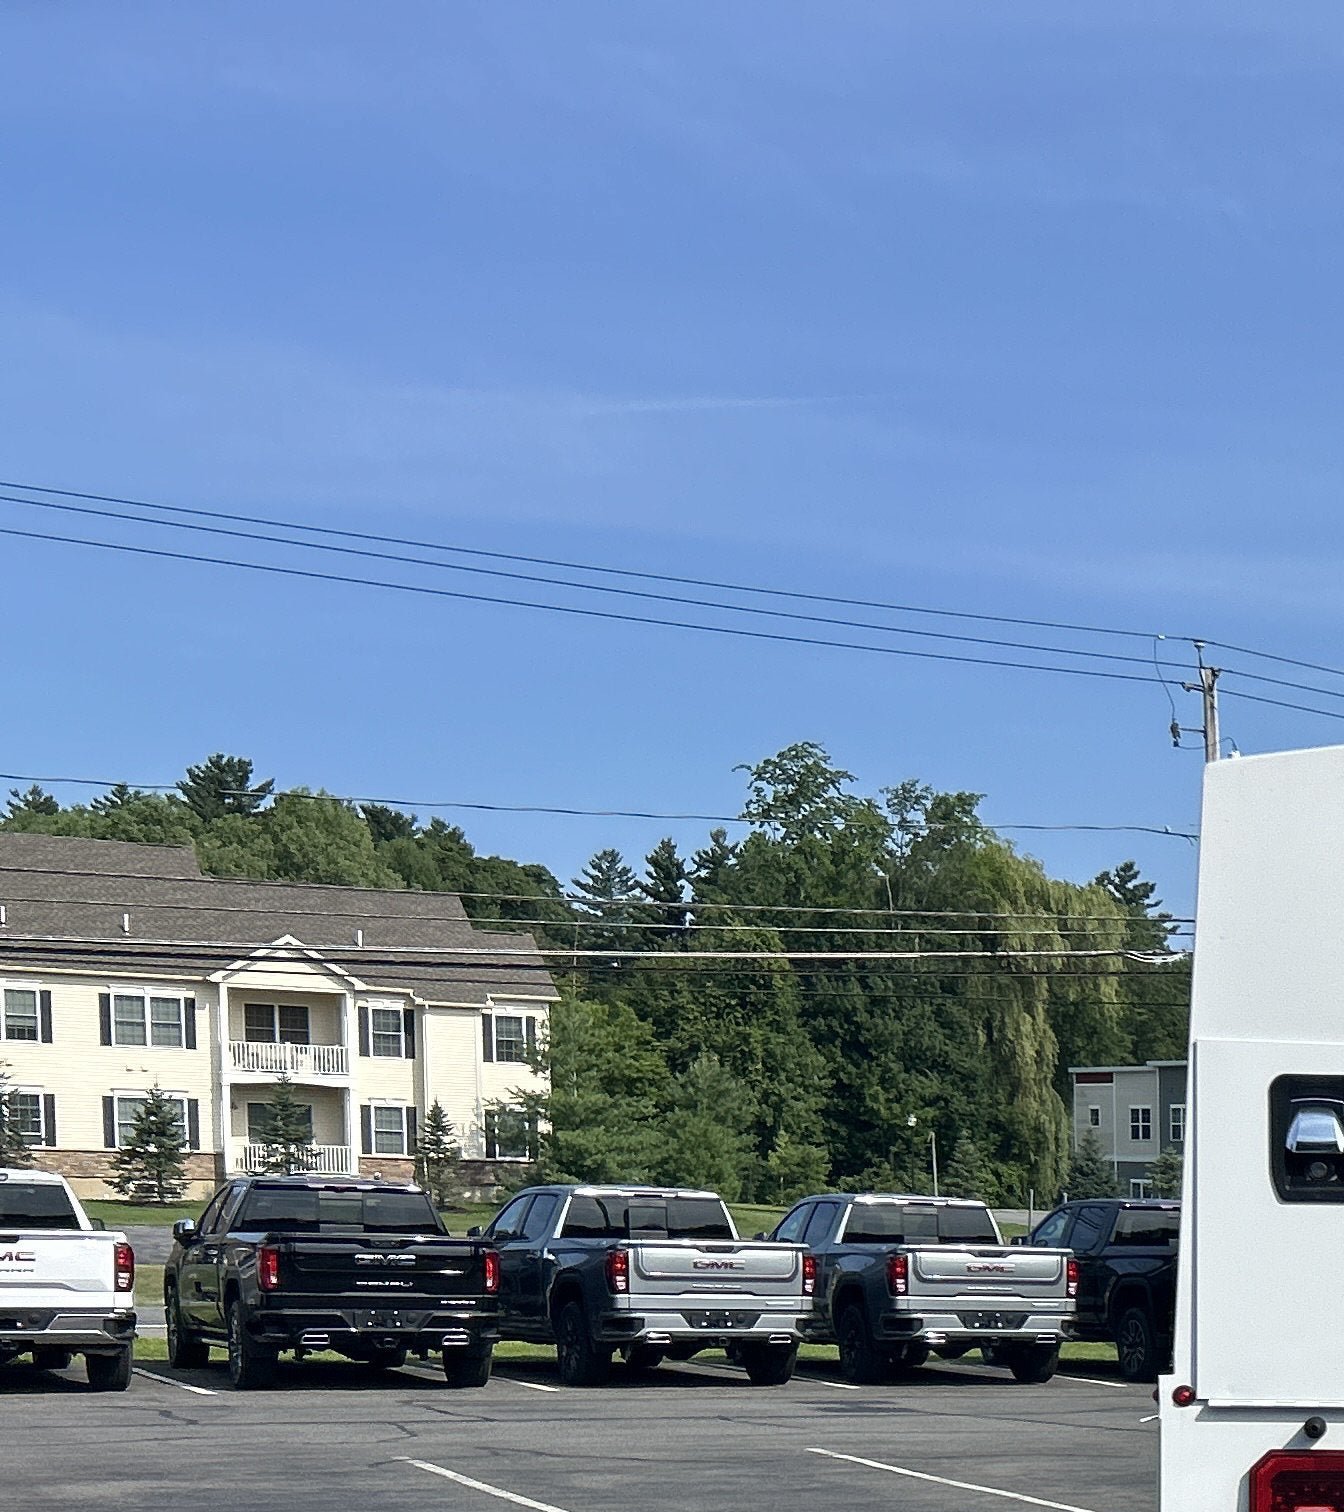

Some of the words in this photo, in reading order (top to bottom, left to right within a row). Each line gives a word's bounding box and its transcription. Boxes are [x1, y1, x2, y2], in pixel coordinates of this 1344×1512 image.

[0, 1251, 36, 1262] MC
[691, 1258, 746, 1271] GMC
[965, 1262, 1016, 1273] GMC
